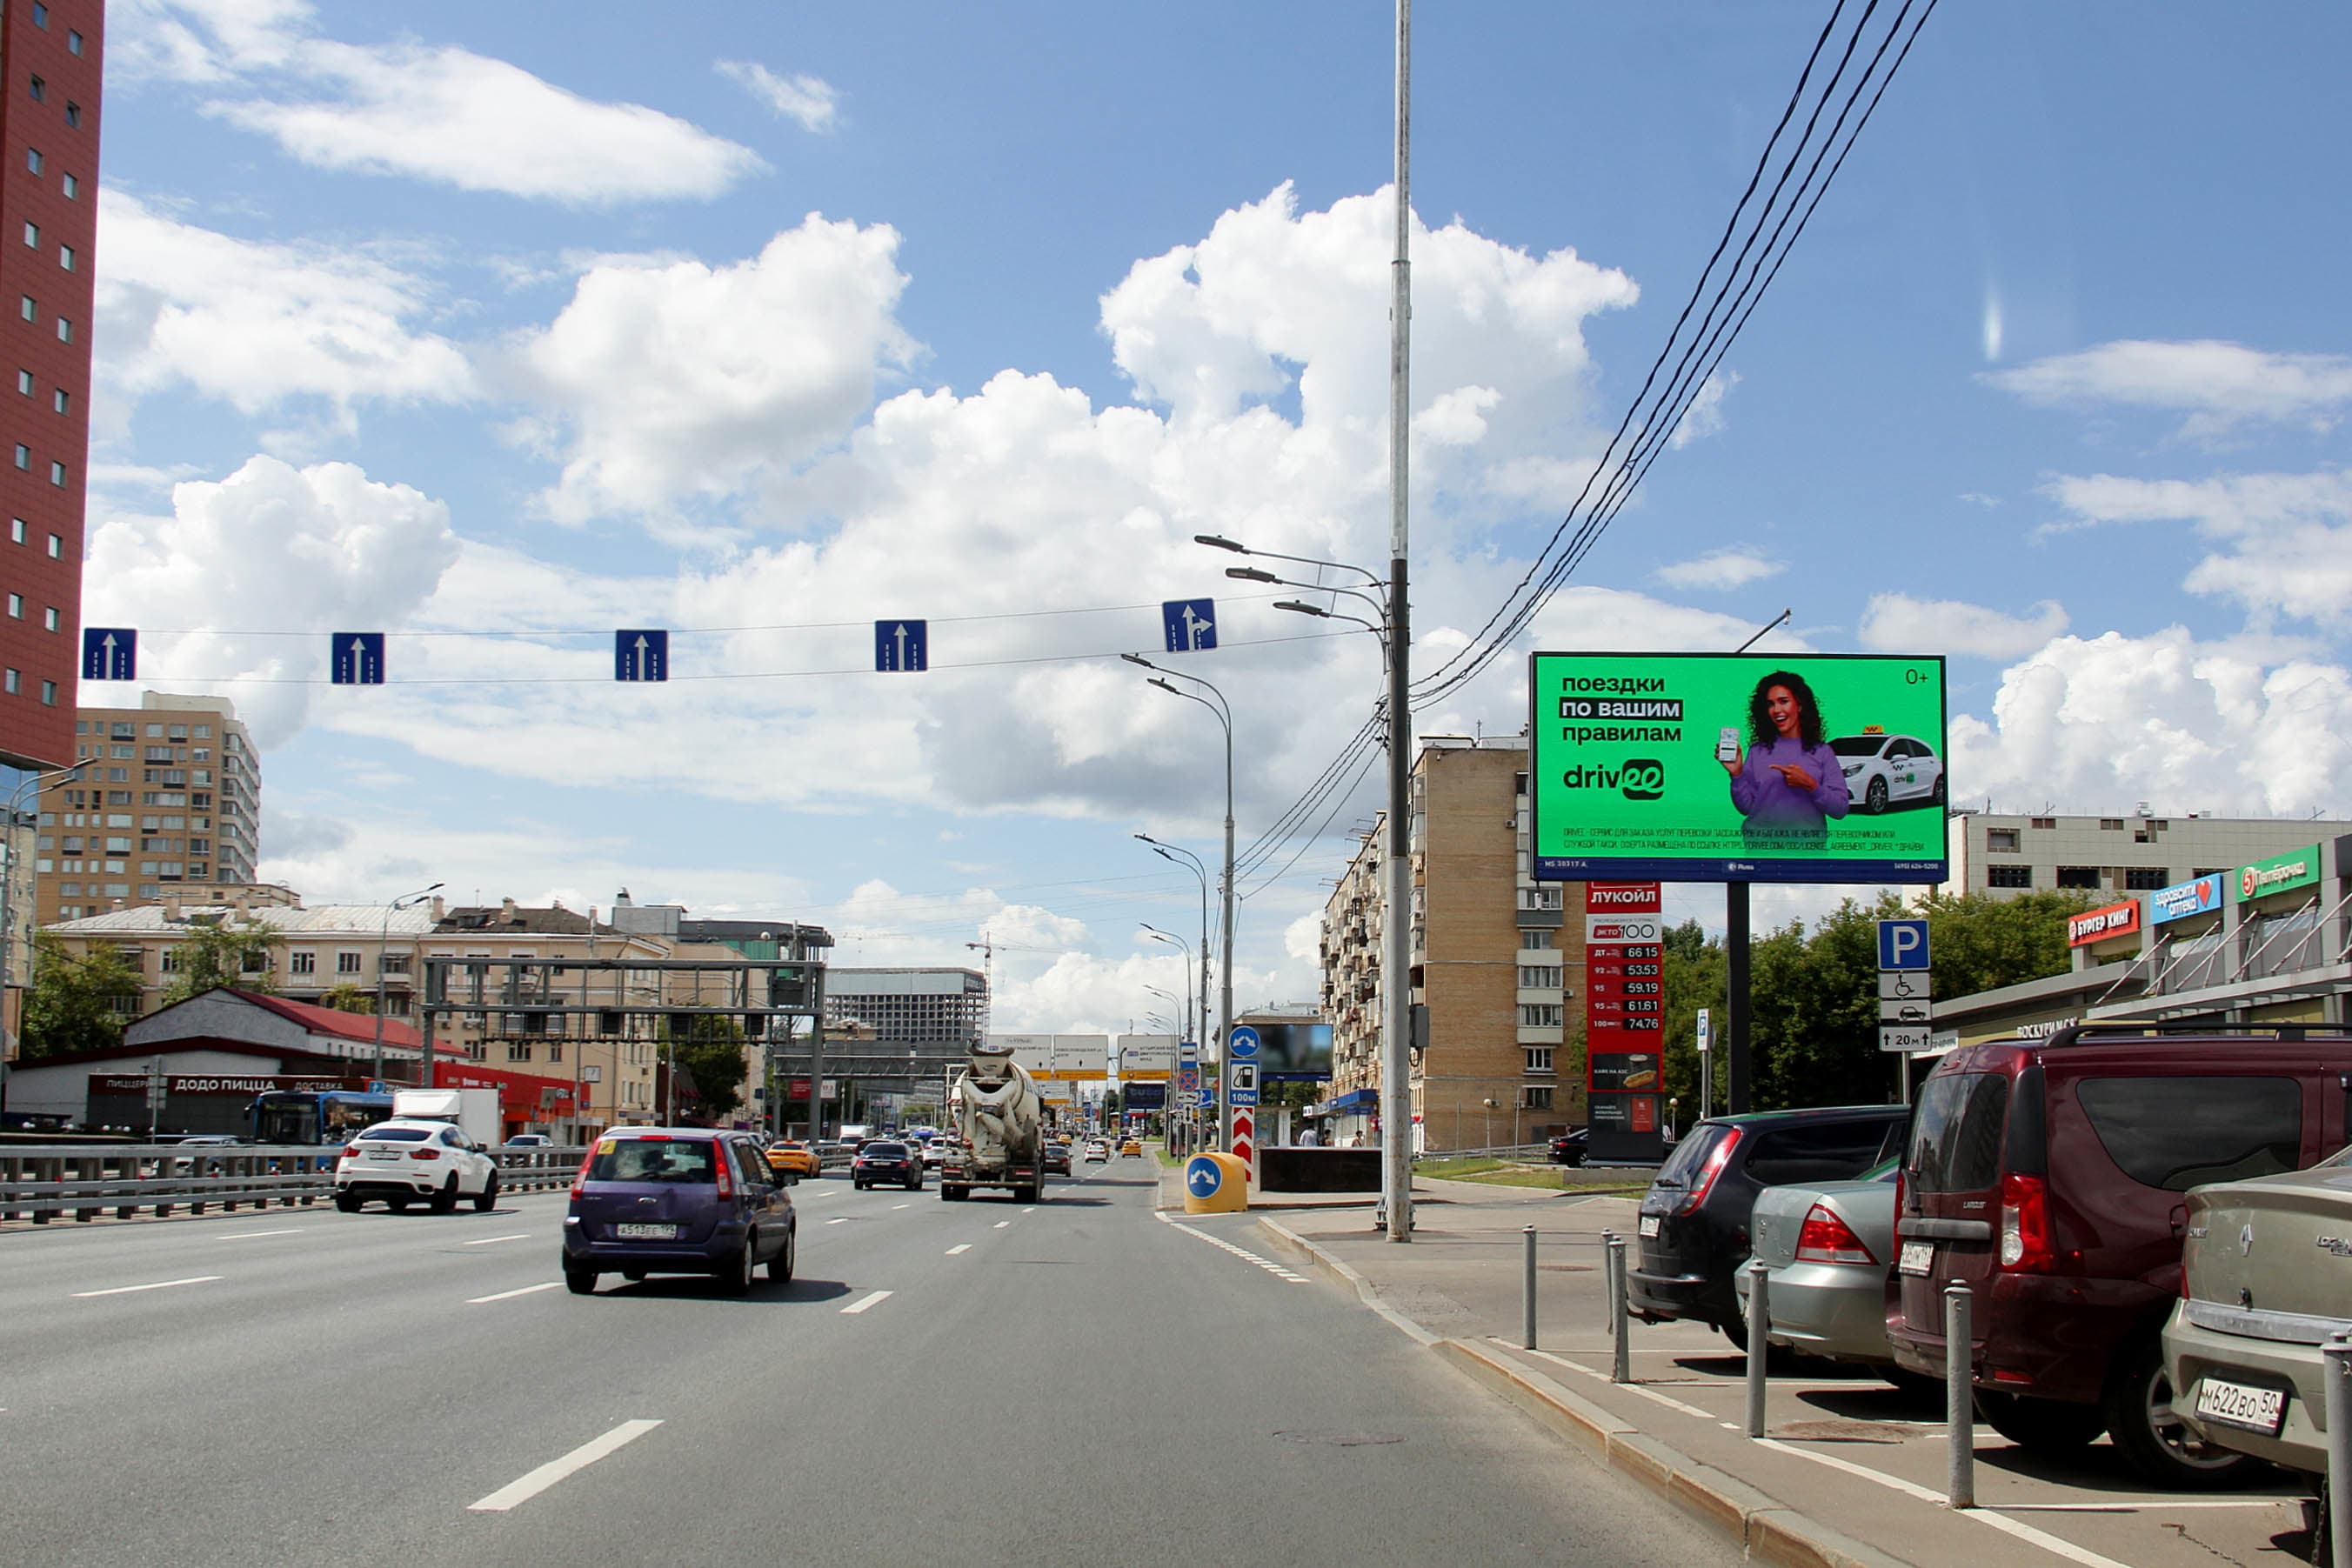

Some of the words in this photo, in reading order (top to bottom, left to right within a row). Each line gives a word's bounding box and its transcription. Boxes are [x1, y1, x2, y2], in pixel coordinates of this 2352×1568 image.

[1906, 669, 1928, 684] 0+
[1562, 677, 1665, 695] поездки
[1562, 702, 1592, 717] по
[1599, 702, 1680, 717] вашим
[1562, 726, 1681, 745] правилам
[1563, 759, 1665, 800] drivee
[1591, 888, 1656, 903] ЛУКОЙЛ
[2077, 916, 2105, 937] БУРГЕР
[2107, 908, 2129, 929] КИНГ
[1619, 924, 1655, 939] 100
[1893, 925, 1920, 964] P
[1594, 949, 1606, 957] ДТ
[1627, 964, 1658, 976] 53.53
[1627, 983, 1658, 993] 59.19
[106, 1079, 149, 1089] ПИЦЦЕР
[176, 1078, 219, 1091] ДОДО
[222, 1079, 276, 1093] ПИЦЦА
[295, 1081, 344, 1091] ДОСТАВКА
[1233, 1093, 1255, 1102] 100м
[2261, 1391, 2277, 1414] 50
